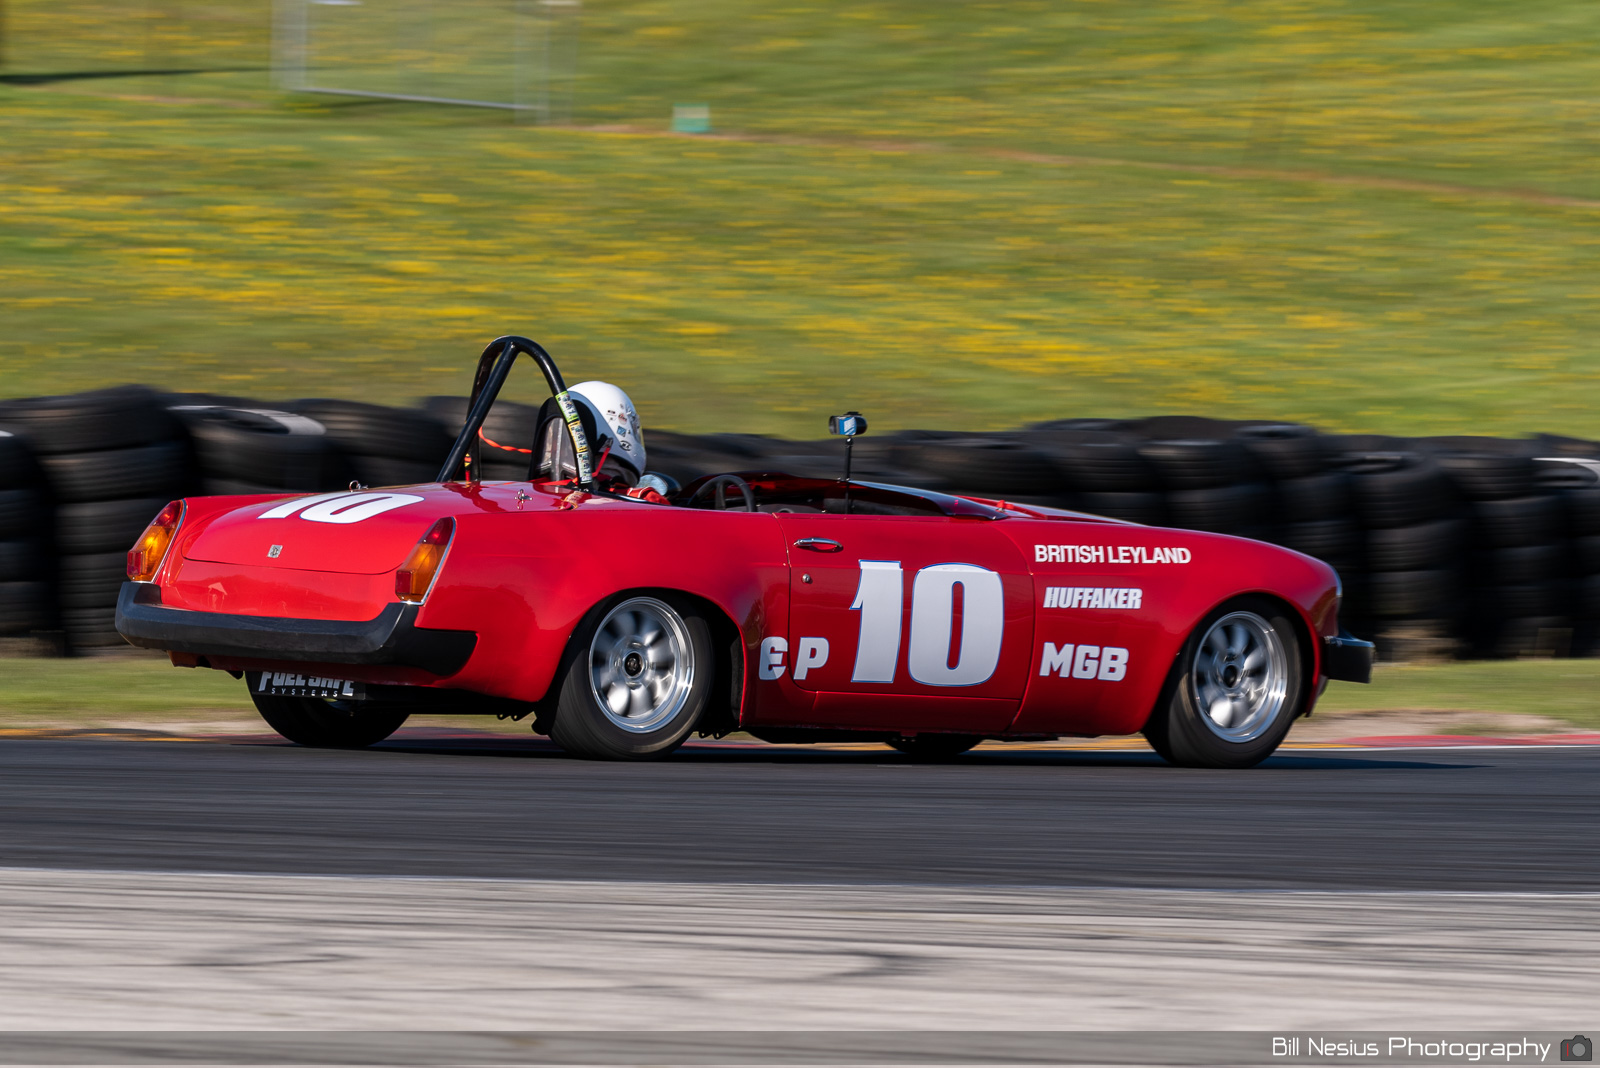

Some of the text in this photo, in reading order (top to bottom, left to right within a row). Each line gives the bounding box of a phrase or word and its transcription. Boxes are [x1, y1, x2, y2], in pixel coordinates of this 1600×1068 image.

[256, 491, 425, 524] 10
[1034, 544, 1192, 564] BRITISH LEYLAND
[1043, 586, 1143, 609] HUFFAKER
[848, 559, 1005, 687] 10
[1039, 642, 1129, 682] MGB
[271, 687, 338, 697] SYSTEMS
